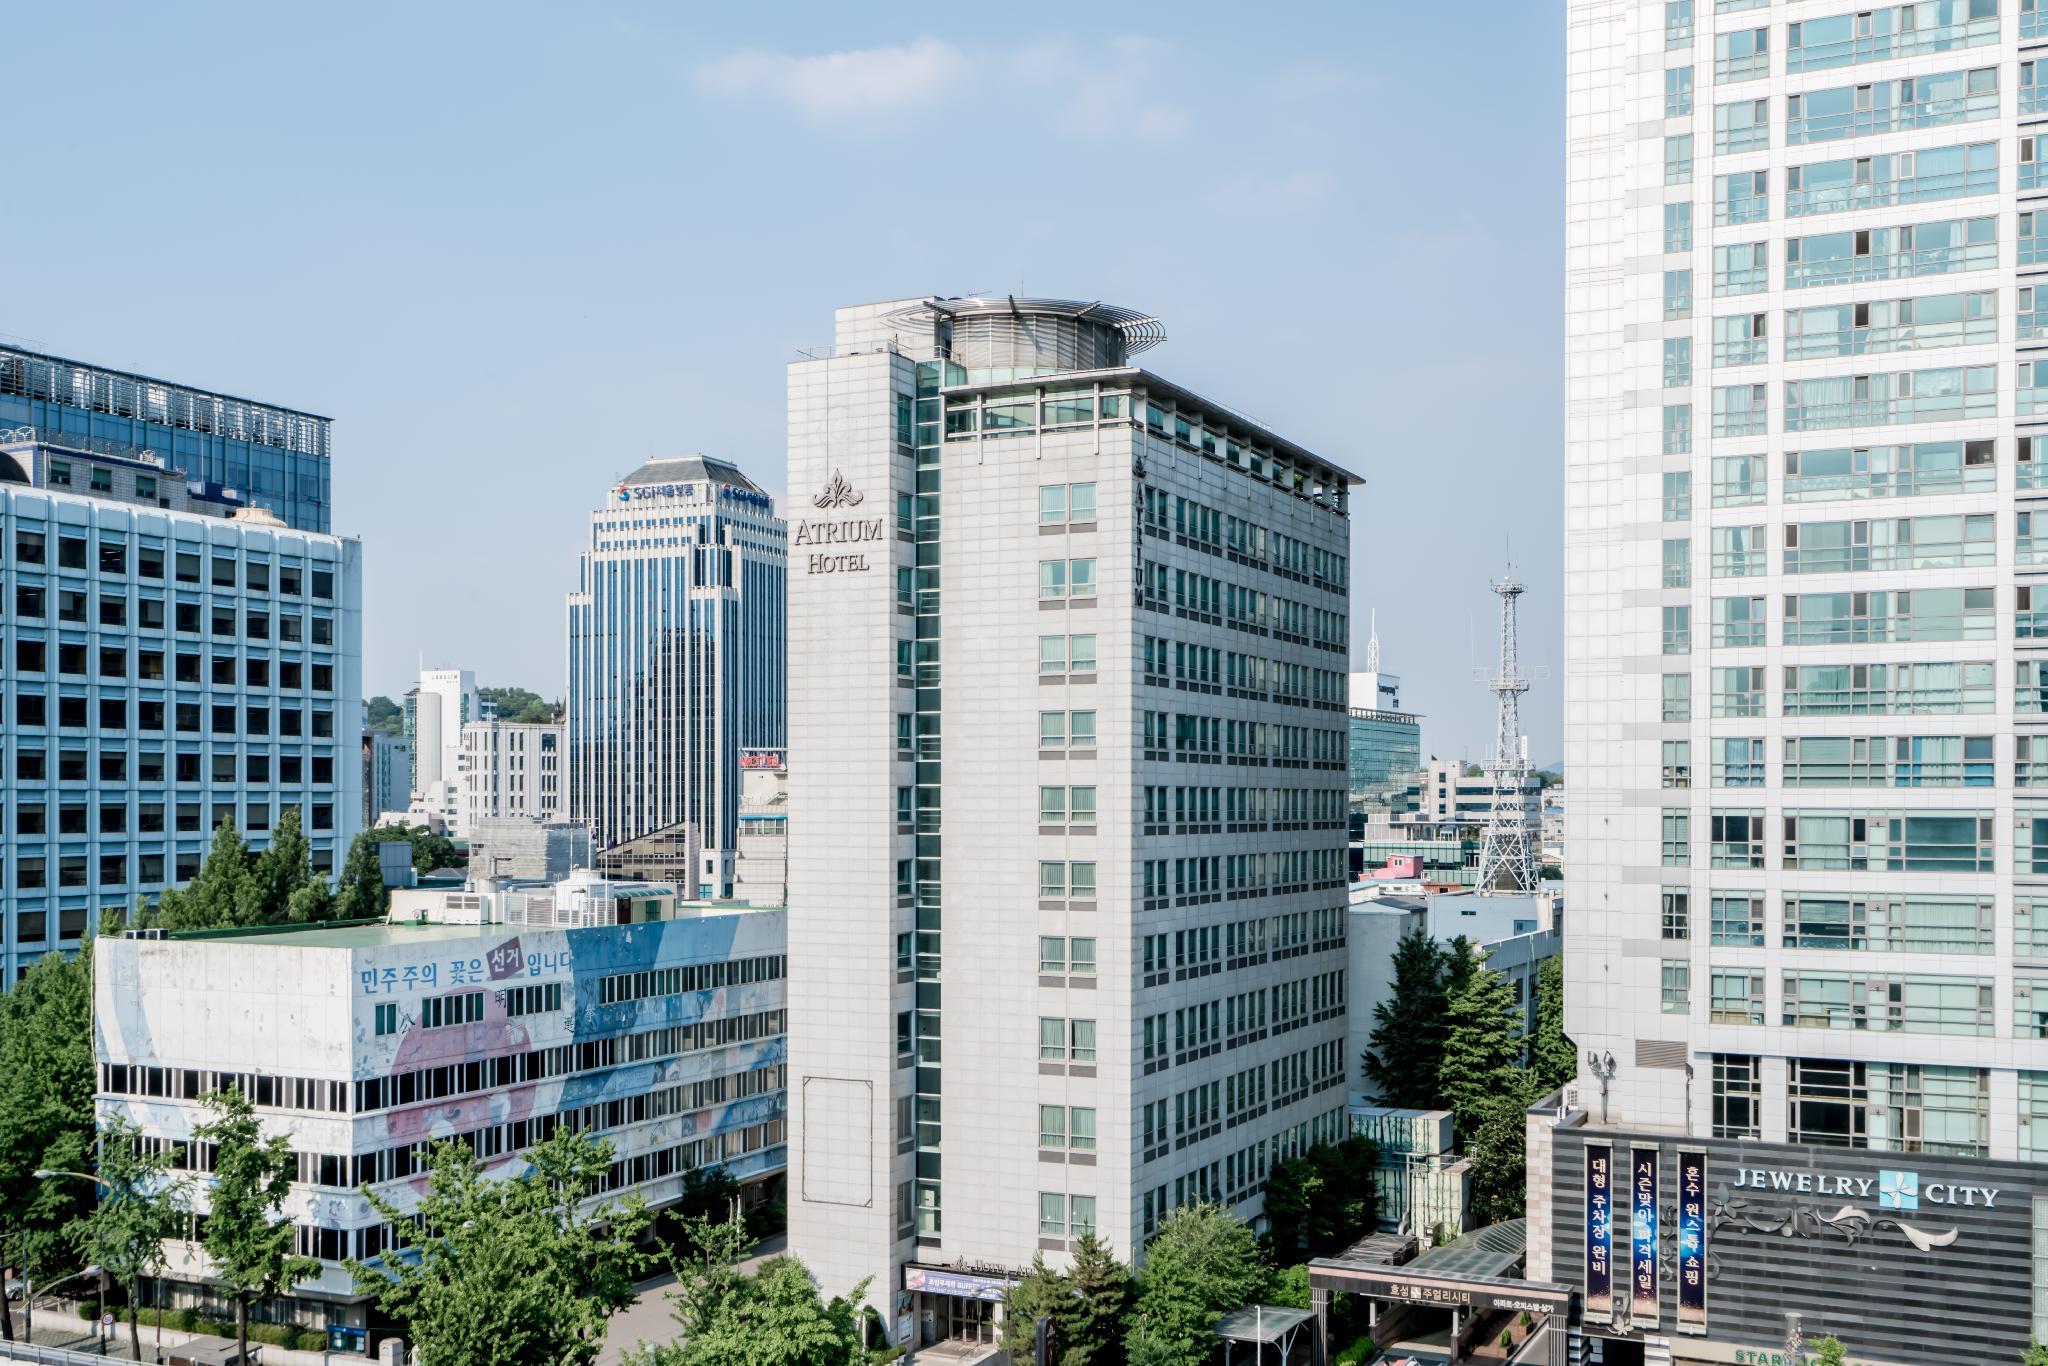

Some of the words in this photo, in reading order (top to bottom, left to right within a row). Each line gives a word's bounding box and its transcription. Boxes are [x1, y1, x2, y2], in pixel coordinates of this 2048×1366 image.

[795, 519, 883, 546] ATRIUM
[808, 553, 869, 574] HOTEL
[361, 962, 437, 994] 민주주의
[450, 958, 484, 985] 꽃은
[491, 947, 520, 972] 선거
[528, 951, 574, 976] 입니다
[1592, 1158, 1606, 1188] 대형
[1685, 1166, 1700, 1197] 혼수
[1734, 1168, 1873, 1198] JEWELRY
[1925, 1183, 2000, 1208] CITY
[1637, 1162, 1653, 1223] 시즌맞이
[1592, 1194, 1606, 1239] 주차장
[1592, 1245, 1606, 1276] 완비
[1685, 1255, 1700, 1285] 쇼핑
[1390, 1285, 1409, 1297] 효성
[1423, 1289, 1471, 1304] 주얼리시티
